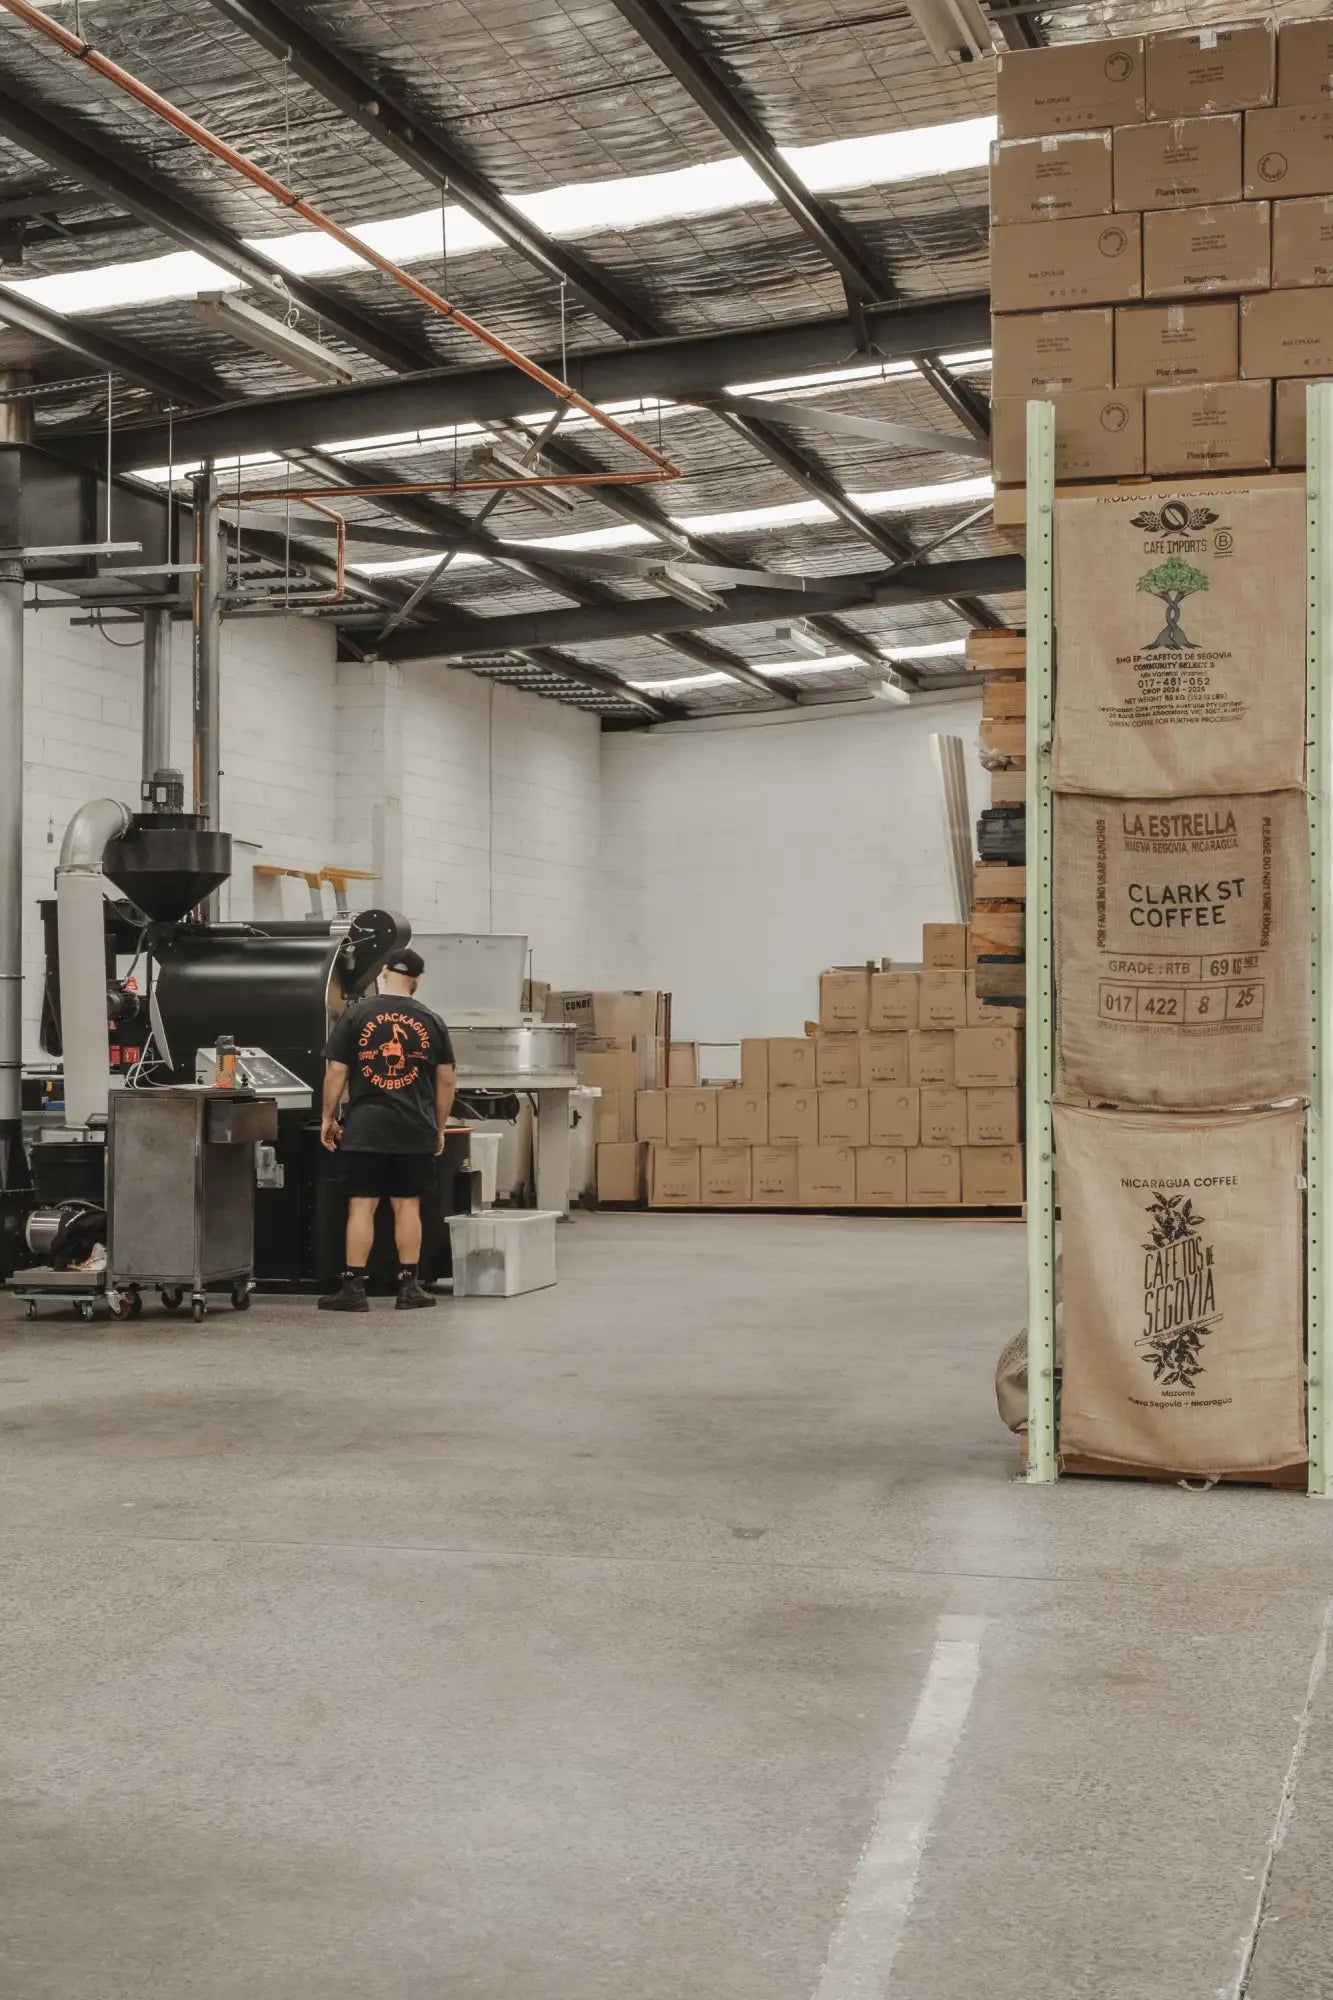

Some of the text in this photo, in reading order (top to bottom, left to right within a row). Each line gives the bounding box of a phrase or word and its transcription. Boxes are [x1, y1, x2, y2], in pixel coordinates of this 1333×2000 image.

[1143, 539, 1208, 555] CAFE IMPORTS
[1196, 651, 1233, 659] SEGOVIA
[1133, 662, 1177, 671] COMMUNITY
[1124, 697, 1136, 705] NET
[1122, 810, 1237, 837] LA ESTRELLA
[1124, 840, 1150, 852] NUEVA
[1128, 878, 1245, 905] CLARK ST
[1129, 905, 1226, 928] COFFEE
[1108, 960, 1154, 975] GRADE
[1165, 962, 1190, 975] RTB
[1210, 956, 1259, 977] 69 KG NET
[1105, 994, 1133, 1013] 017
[1145, 997, 1178, 1016] 422
[1198, 995, 1210, 1014] 8
[1235, 987, 1256, 1009] 25
[358, 1012, 430, 1049] OUR PACKAGING
[361, 1065, 373, 1077] IS
[1121, 1175, 1239, 1189] NICARAGUA COFFEE
[1144, 1236, 1204, 1290] CAFETOS
[1143, 1267, 1216, 1337] SEGOVIA
[1149, 1401, 1182, 1409] Segovia
[1190, 1397, 1233, 1407] Nicaragua
